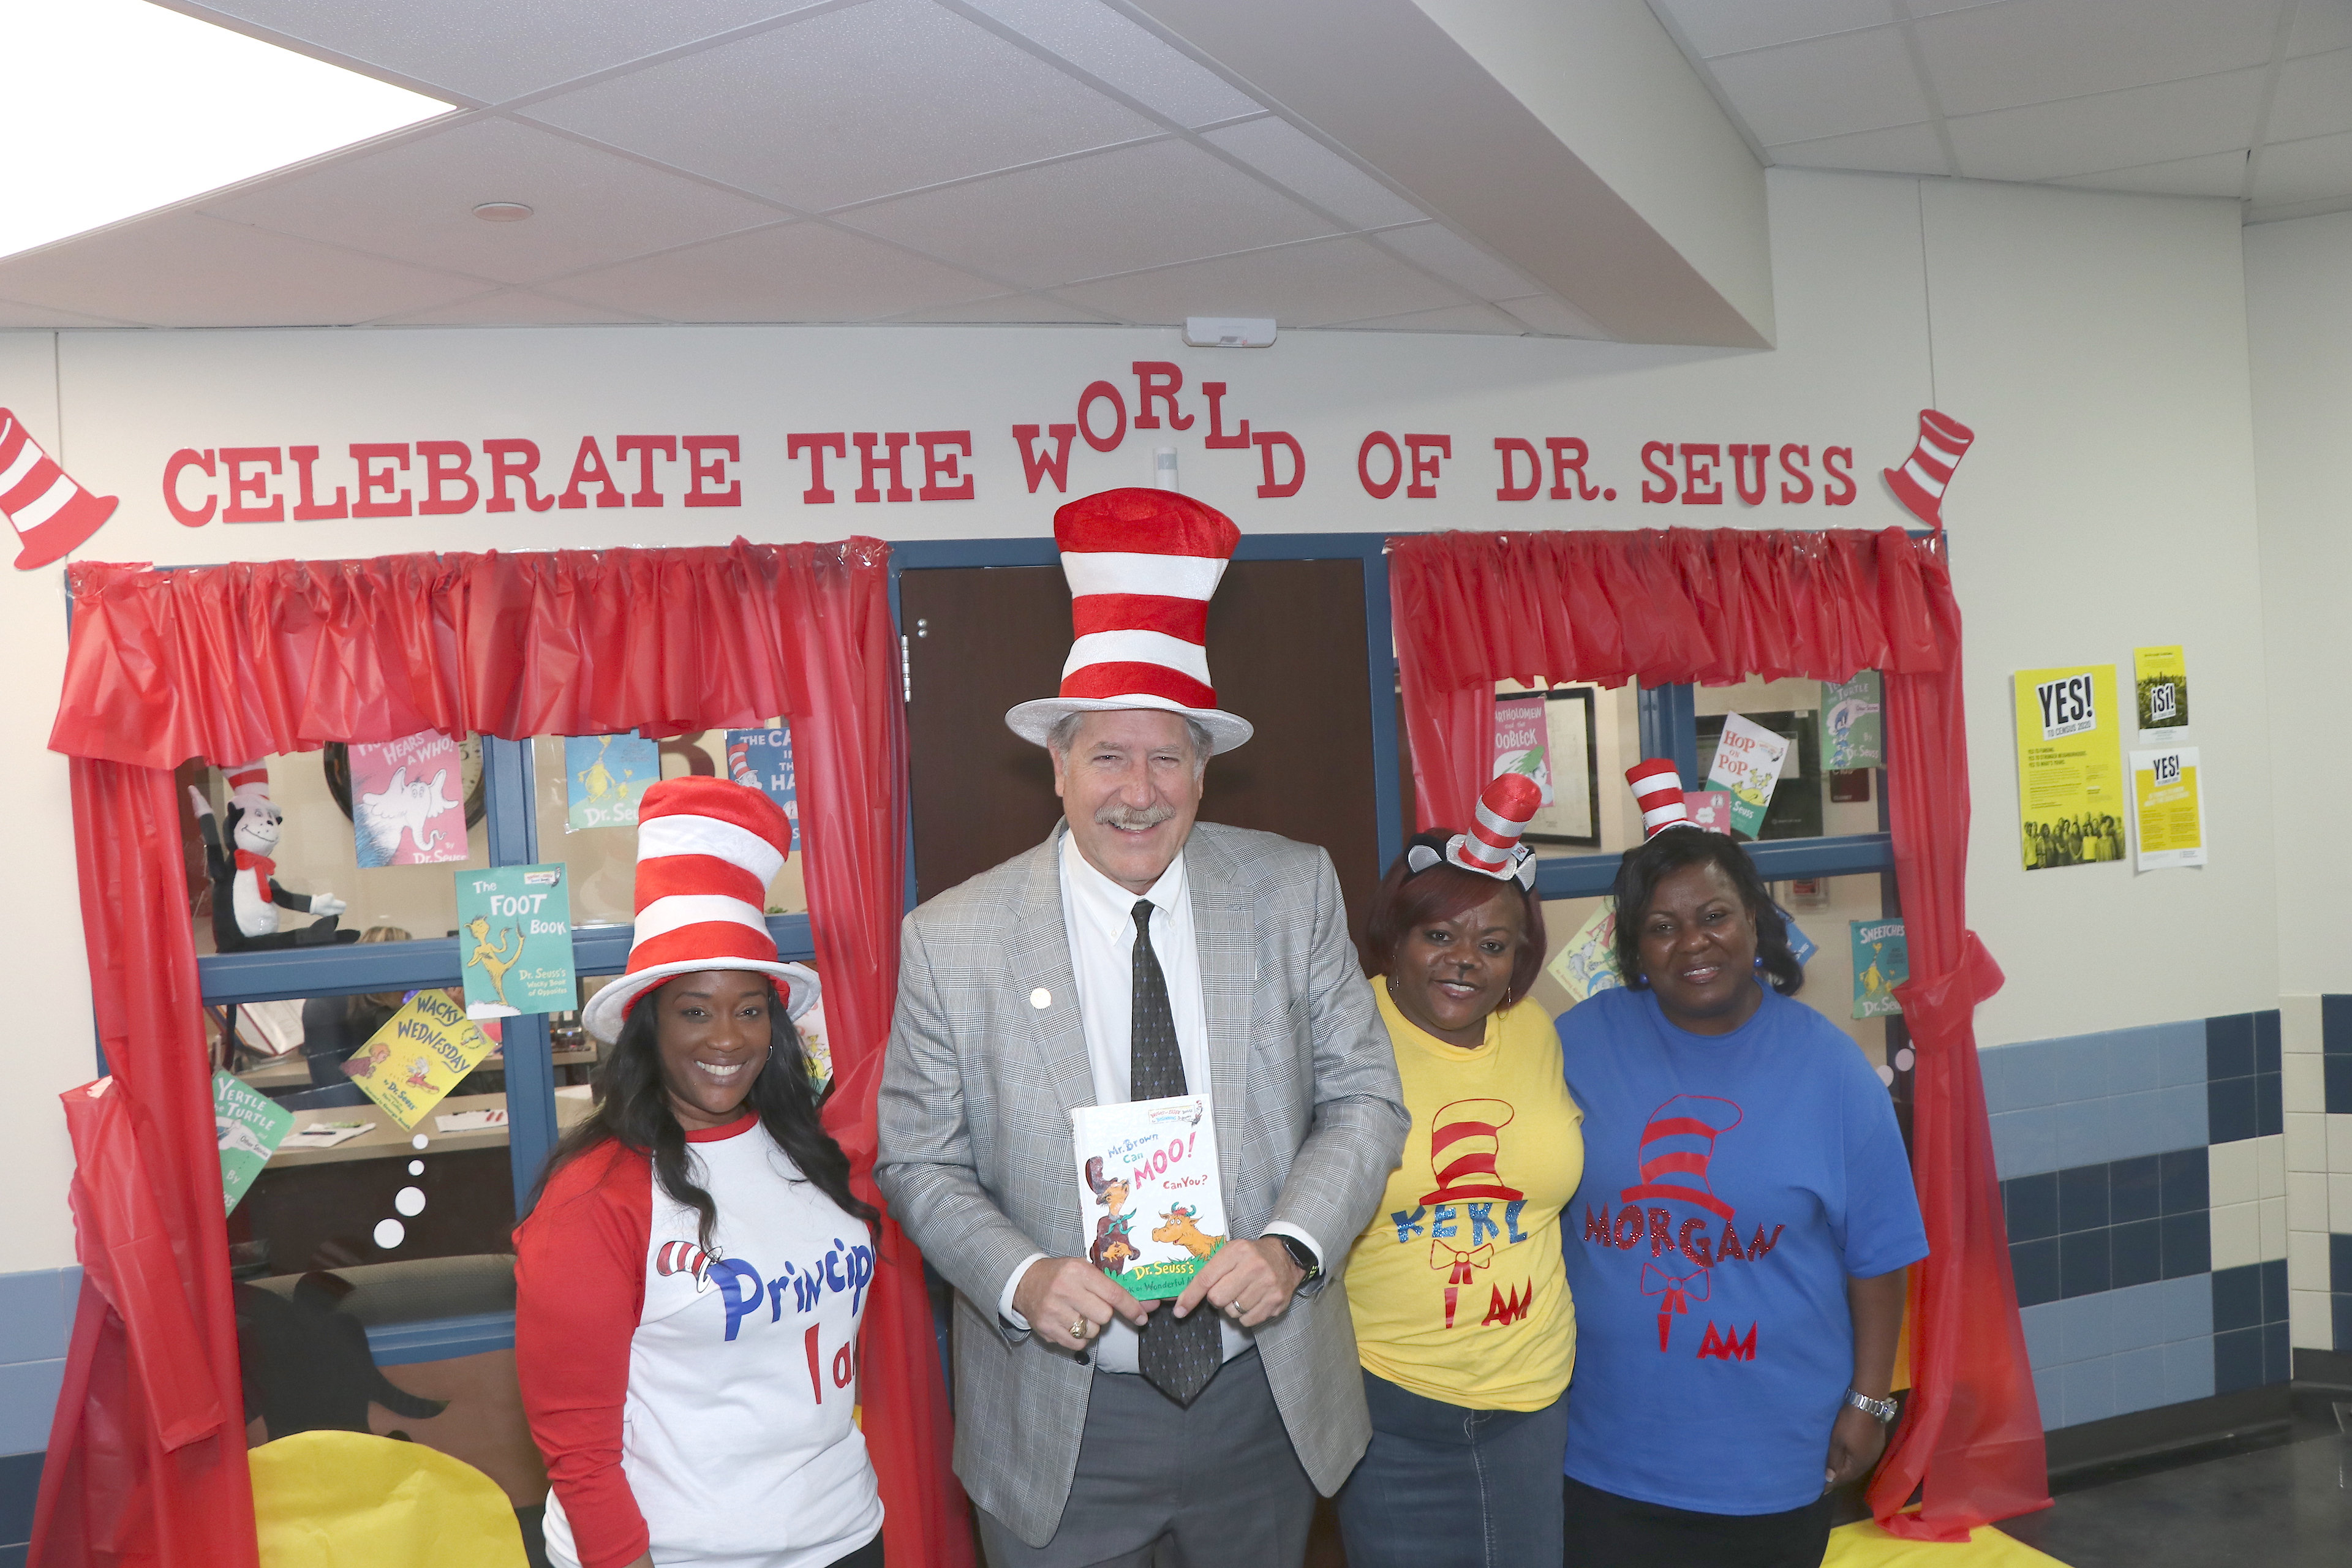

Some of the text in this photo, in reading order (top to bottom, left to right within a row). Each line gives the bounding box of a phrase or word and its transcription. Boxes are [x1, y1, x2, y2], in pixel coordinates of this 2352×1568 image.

[164, 362, 1856, 527] CELEBRATE THE WORLD OF DR. SEUSS
[1837, 683, 1869, 700] TURTLE
[2038, 676, 2093, 727] YES!
[1495, 707, 1542, 722] ARTHOLOMEW
[382, 733, 424, 766] HEARS
[407, 733, 454, 766] A WHO!
[739, 730, 791, 747] THE CA
[1495, 728, 1538, 749] OOBLECK
[1724, 729, 1755, 753] HOP
[1860, 745, 1879, 758] Seuss
[779, 762, 794, 771] TH
[1718, 754, 1749, 776] POP
[2154, 755, 2179, 780] YES!
[771, 774, 796, 791] HA
[584, 807, 611, 827] Dr.
[1732, 801, 1755, 819] Seuss
[472, 880, 497, 894] The
[490, 894, 548, 917] FOOT
[530, 919, 567, 935] BOOK
[1860, 924, 1905, 944] SNEETCHES
[519, 968, 566, 981] Dr. Seuss's
[417, 995, 464, 1027] WACKY
[1863, 1001, 1880, 1017] Dr.
[398, 1019, 471, 1073] WEDNESDAY
[218, 1077, 267, 1112] YERTLE
[388, 1082, 399, 1095] Dr.
[398, 1091, 415, 1110] Seuss
[227, 1102, 276, 1131] TURTLE
[240, 1135, 269, 1158] Other Stories
[1108, 1133, 1159, 1158] Mr. Brown
[1123, 1152, 1144, 1164] Can
[1134, 1131, 1196, 1190] MOO!
[226, 1169, 241, 1185] By
[1584, 1201, 1786, 1268] MORGAN
[1133, 1261, 1194, 1280] Dr. Seuss's
[706, 1237, 876, 1342] Princip
[1144, 1278, 1185, 1291] Wonderful
[1444, 1275, 1532, 1329] I AM
[1657, 1314, 1758, 1363] I AM
[805, 1322, 821, 1404] I
